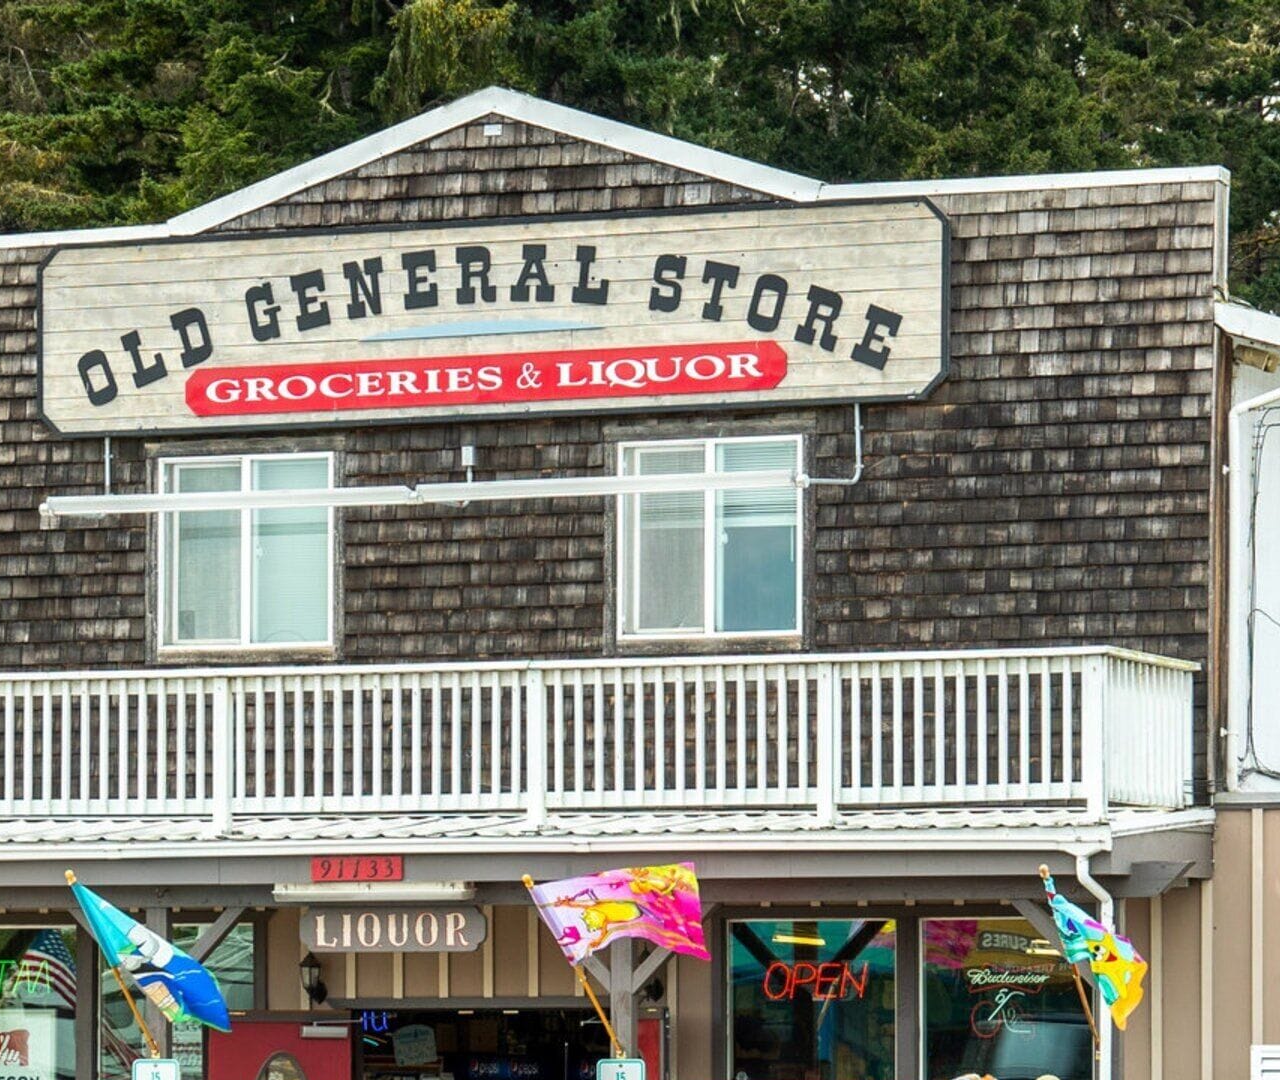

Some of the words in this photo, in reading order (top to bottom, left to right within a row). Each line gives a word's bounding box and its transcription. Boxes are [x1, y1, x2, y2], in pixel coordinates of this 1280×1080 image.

[77, 307, 214, 407] OLD
[245, 244, 609, 342] GENERAL
[649, 254, 903, 371] STORE
[206, 365, 503, 403] GROCERIES
[516, 362, 542, 389] &
[556, 353, 763, 388] LIQUOR
[315, 912, 469, 948] LIQUOR
[762, 961, 869, 1000] OPEN
[967, 967, 1050, 985] Budweiser
